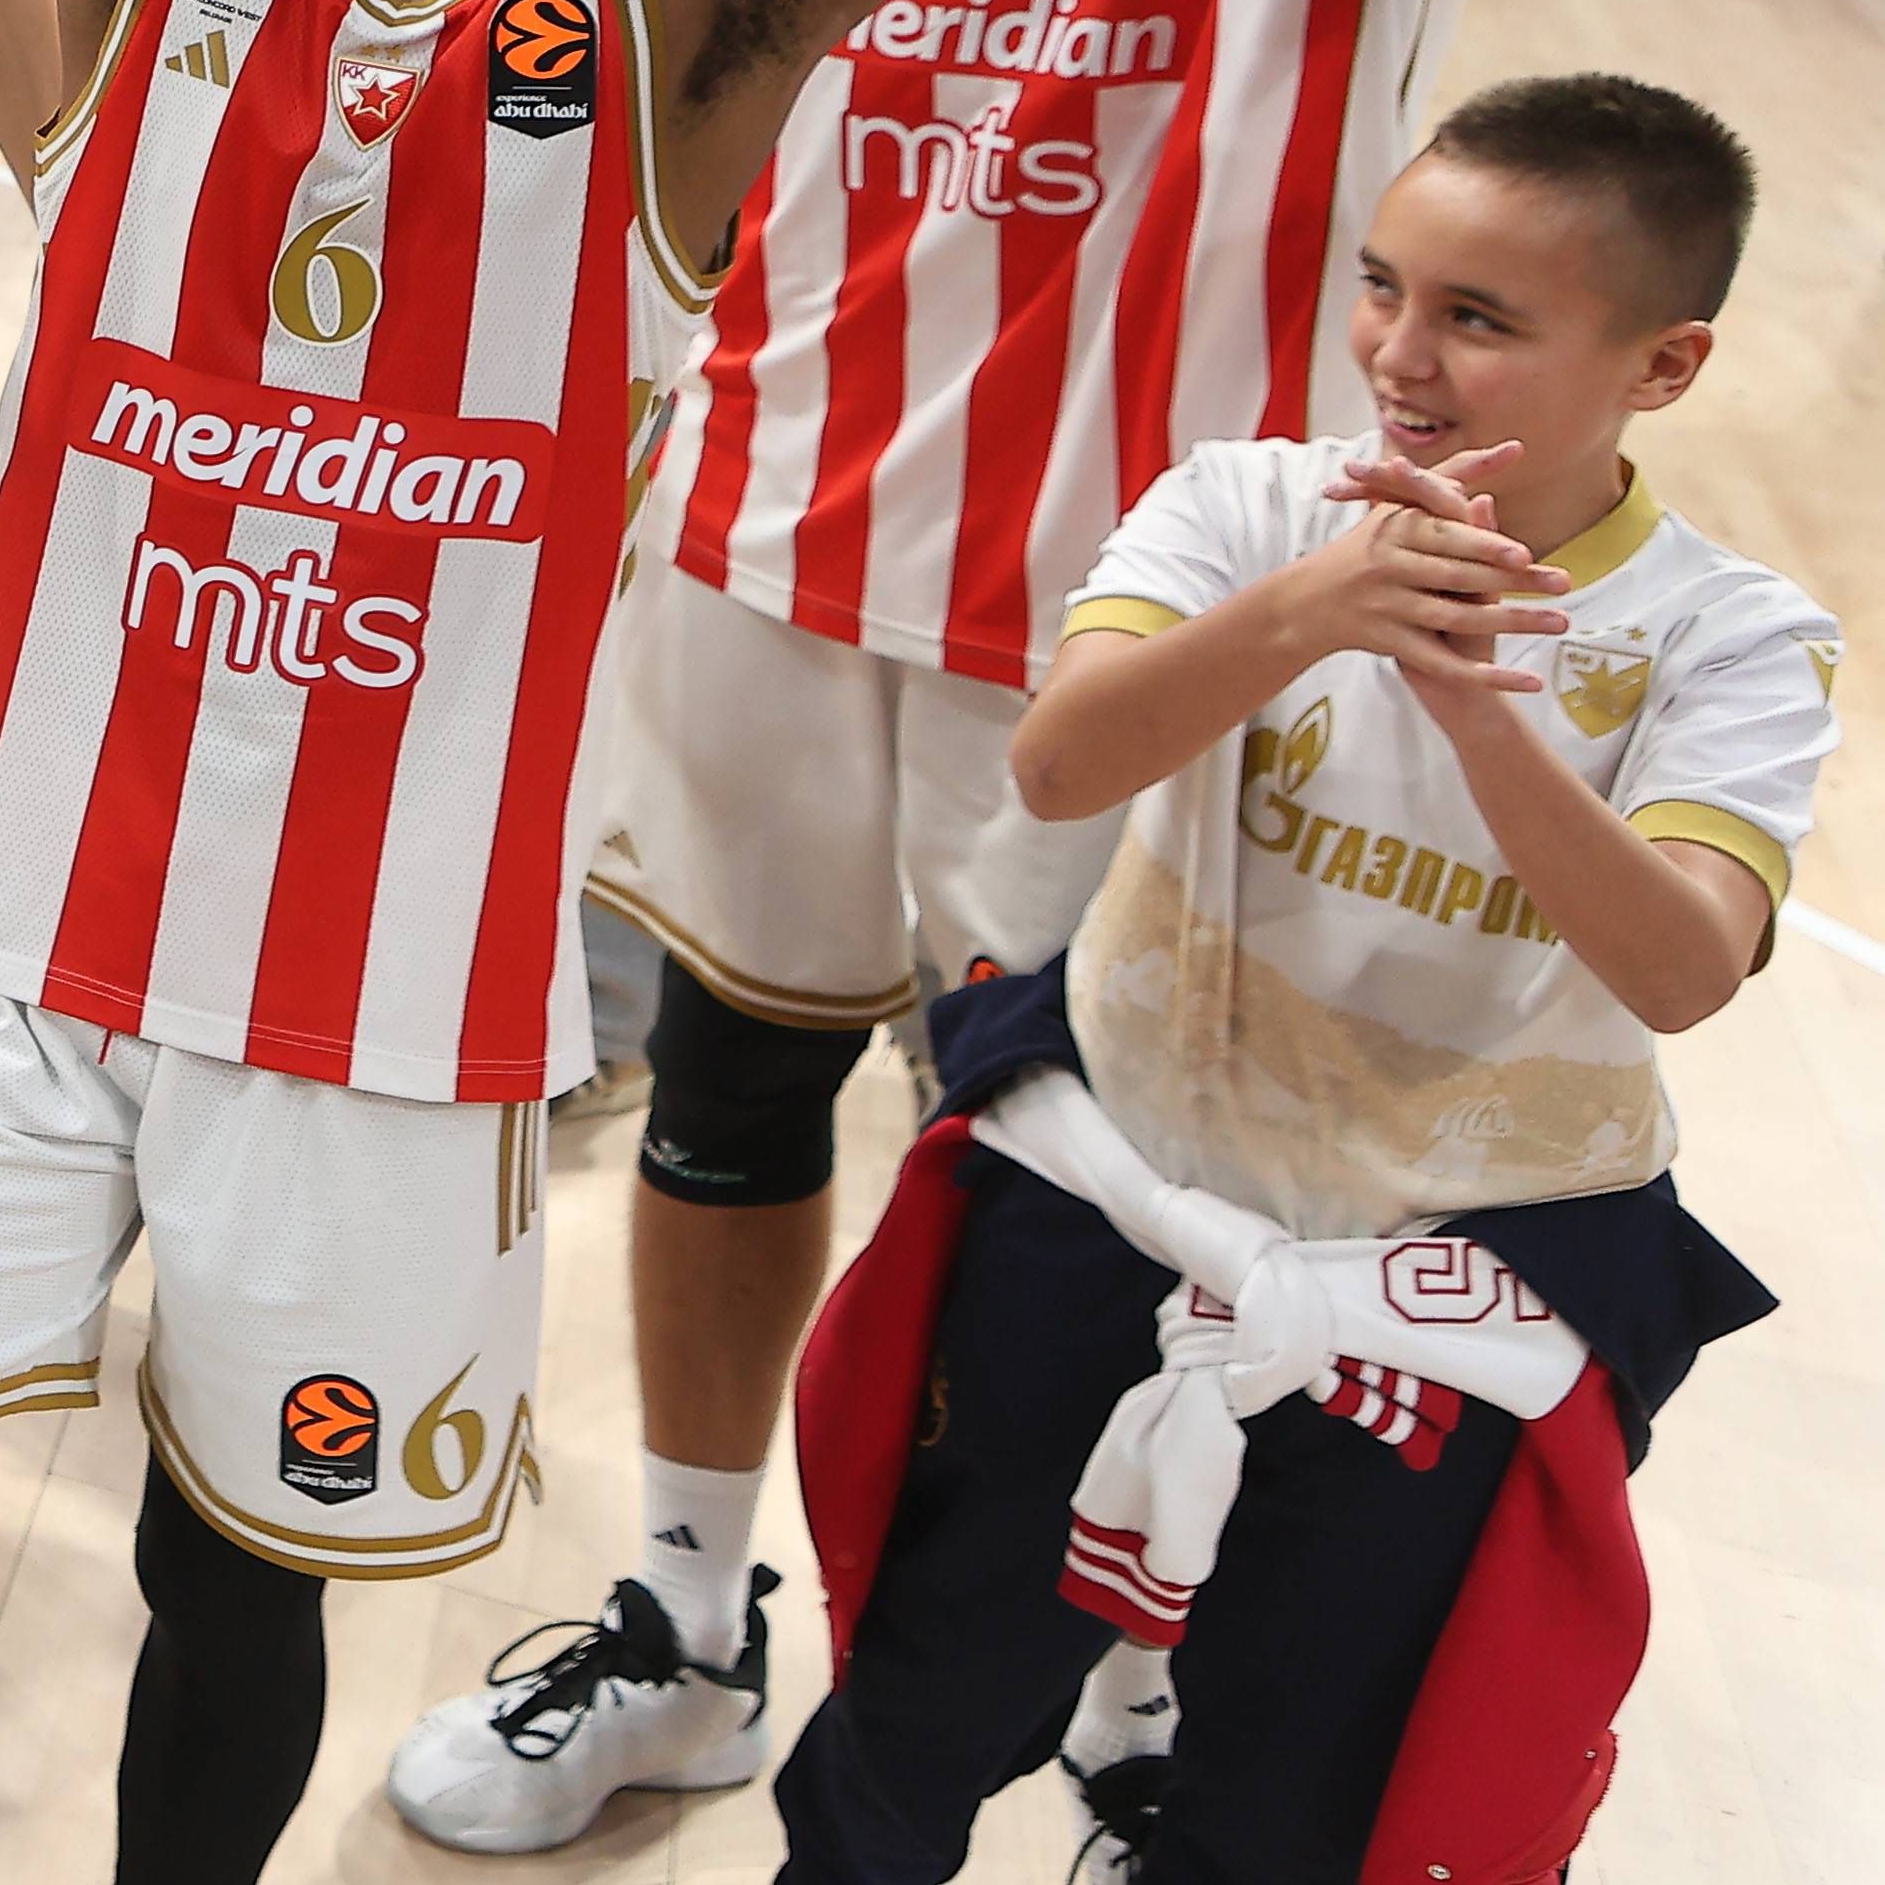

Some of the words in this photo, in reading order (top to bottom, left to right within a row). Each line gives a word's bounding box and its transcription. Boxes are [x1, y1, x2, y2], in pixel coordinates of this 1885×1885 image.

[342, 64, 368, 81] KK
[493, 102, 530, 119] abu
[533, 103, 589, 119] dhabi
[843, 106, 1101, 217] mts
[270, 199, 383, 344] 6
[91, 380, 527, 528] meridian
[127, 539, 424, 688] mts
[402, 1352, 484, 1502] 6
